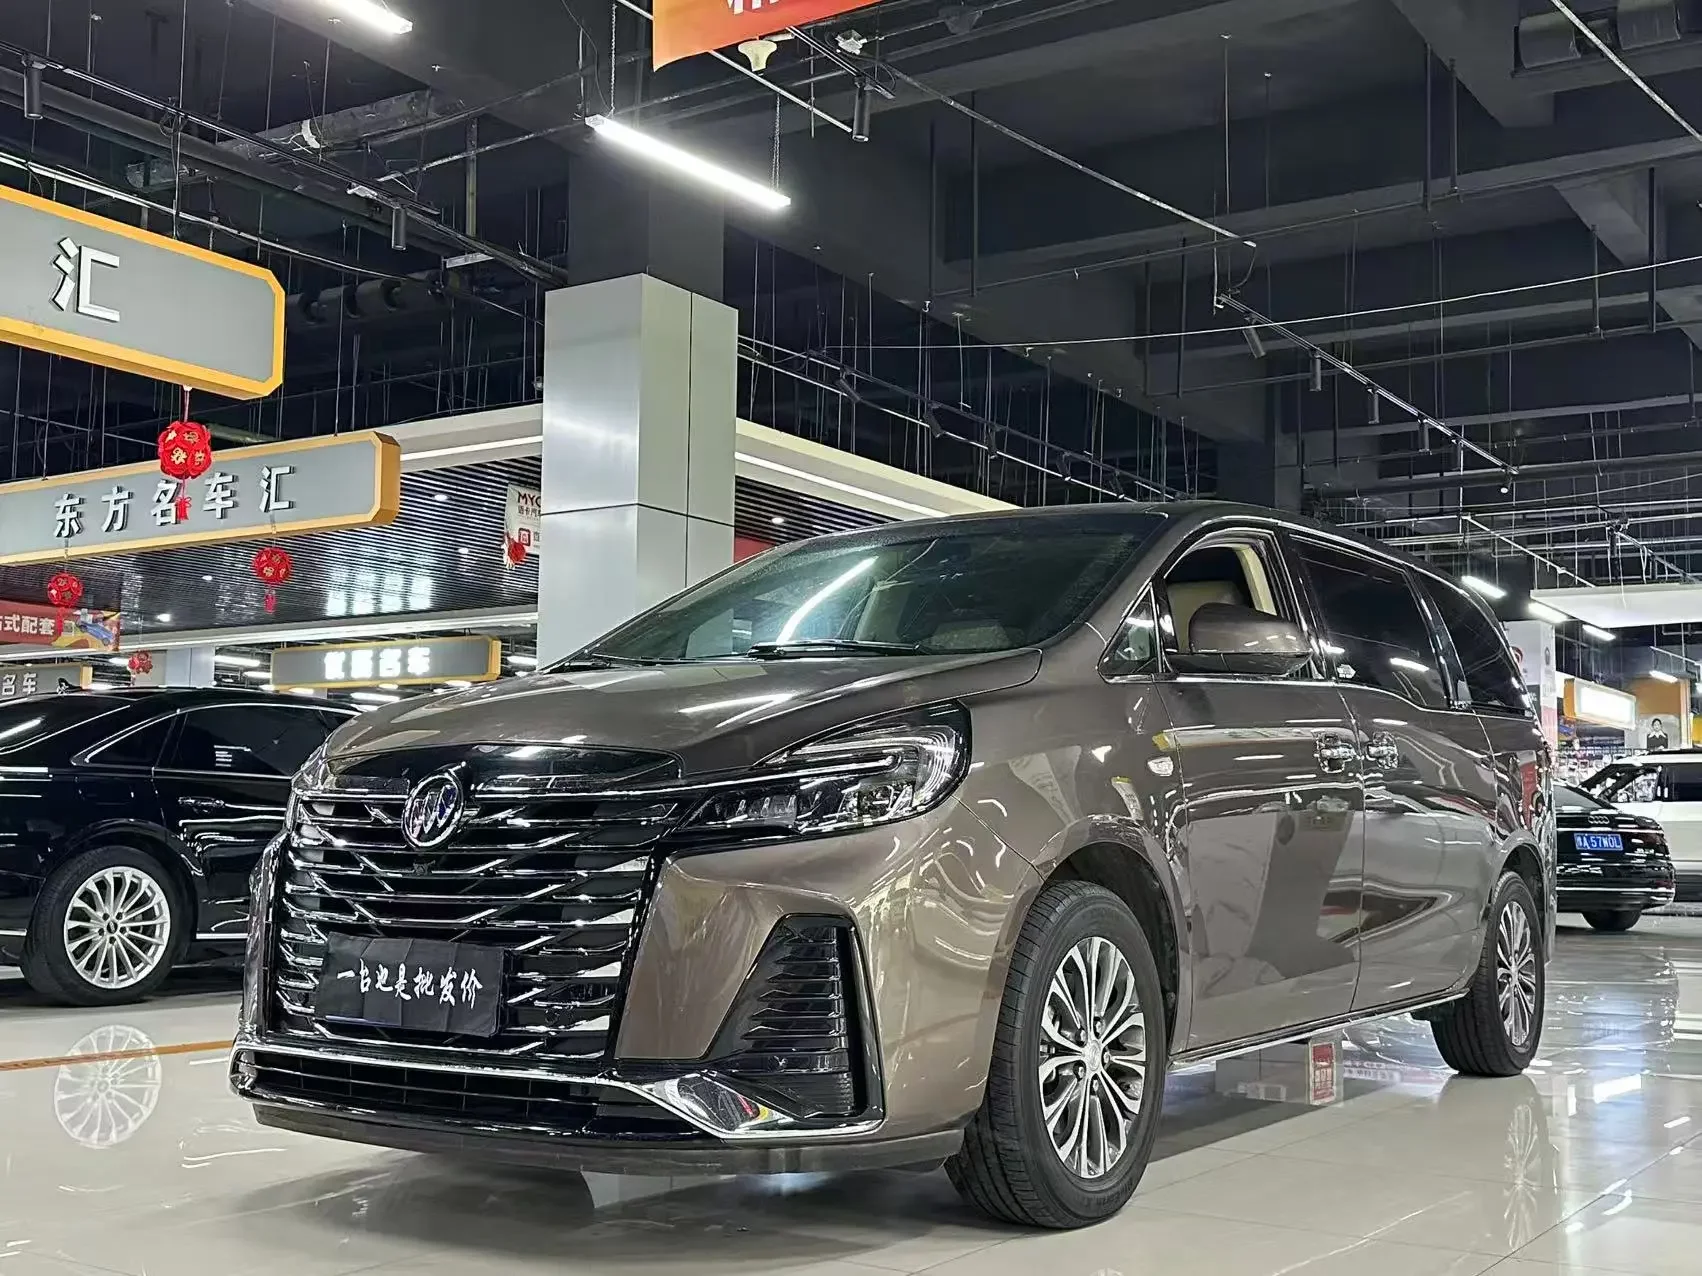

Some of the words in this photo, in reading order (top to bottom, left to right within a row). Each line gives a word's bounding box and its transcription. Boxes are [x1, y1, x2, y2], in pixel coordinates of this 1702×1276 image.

[51, 237, 120, 322] 汇
[53, 465, 297, 538] 东方名车汇
[2, 673, 37, 695] 名车
[336, 958, 483, 1009] 一台也是批发价
